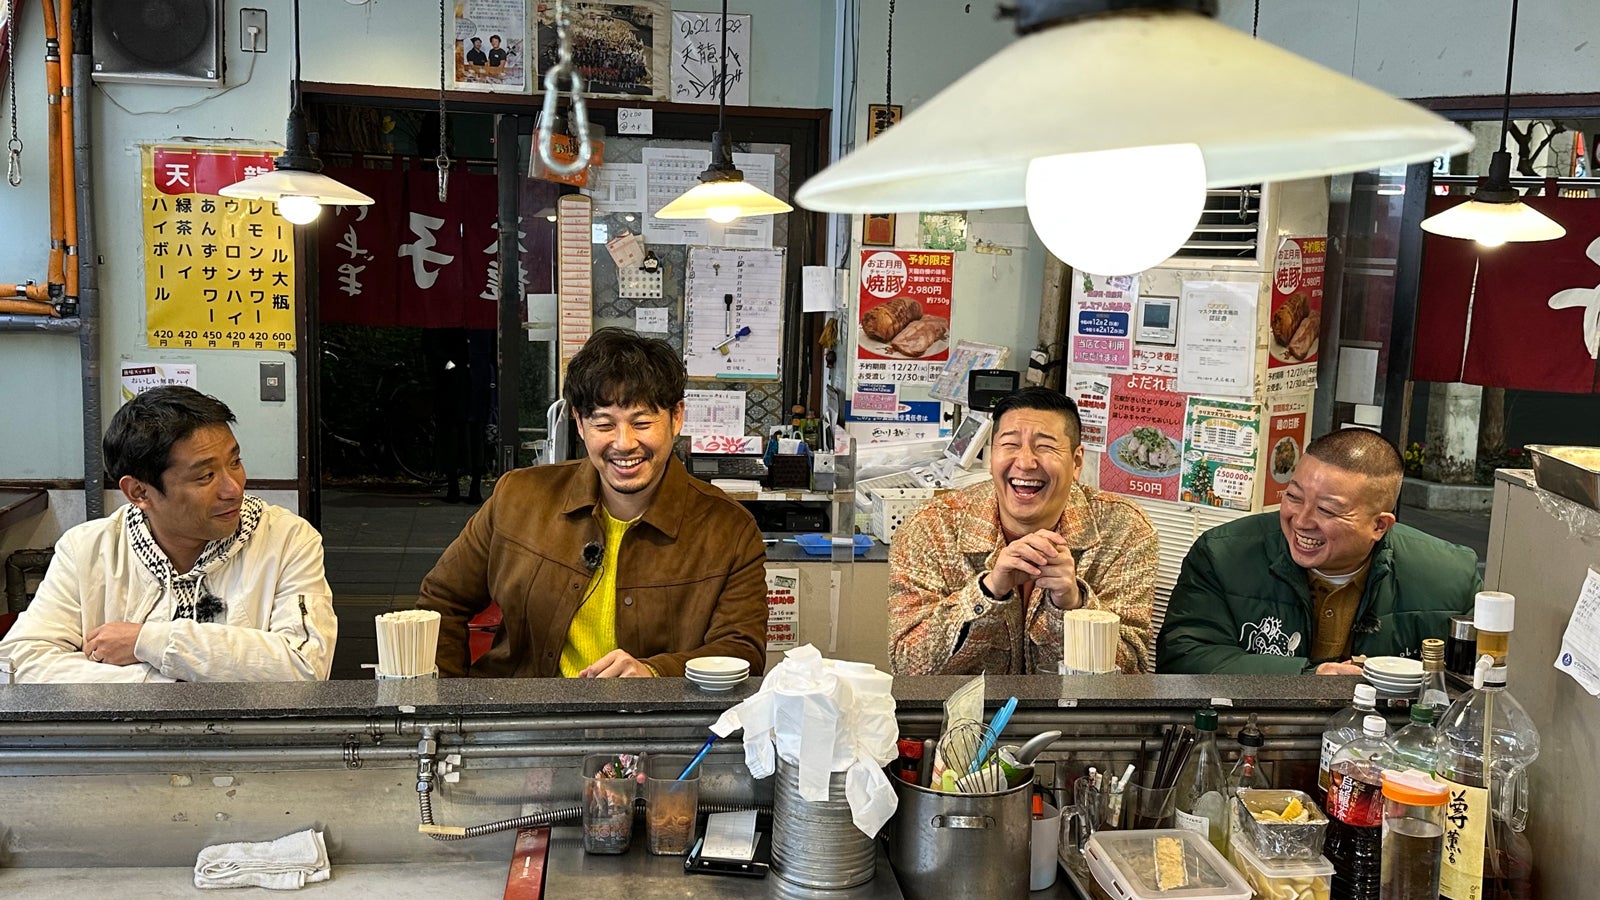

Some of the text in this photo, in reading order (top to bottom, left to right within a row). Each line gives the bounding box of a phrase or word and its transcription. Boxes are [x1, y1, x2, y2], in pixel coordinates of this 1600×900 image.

[175, 198, 192, 279] 緑茶ハイ
[152, 199, 170, 300] ハイボール
[201, 199, 218, 322] あんずサワー
[225, 200, 243, 325] ウーロンハイ
[248, 201, 265, 323] レモンサワー
[867, 259, 903, 268] お正月用
[908, 254, 951, 266] 予約限定
[1277, 266, 1300, 288] 焼豚
[866, 275, 905, 293] 焼豚
[908, 286, 942, 295] 2,980円
[926, 297, 950, 305] 約750g
[154, 330, 174, 339] 420
[178, 330, 198, 339] 420
[202, 331, 222, 340] 450
[226, 332, 246, 341] 420
[249, 332, 269, 341] 420
[272, 332, 292, 342] 600
[1078, 340, 1125, 350] 当店でご利用
[1129, 480, 1162, 495] 550円
